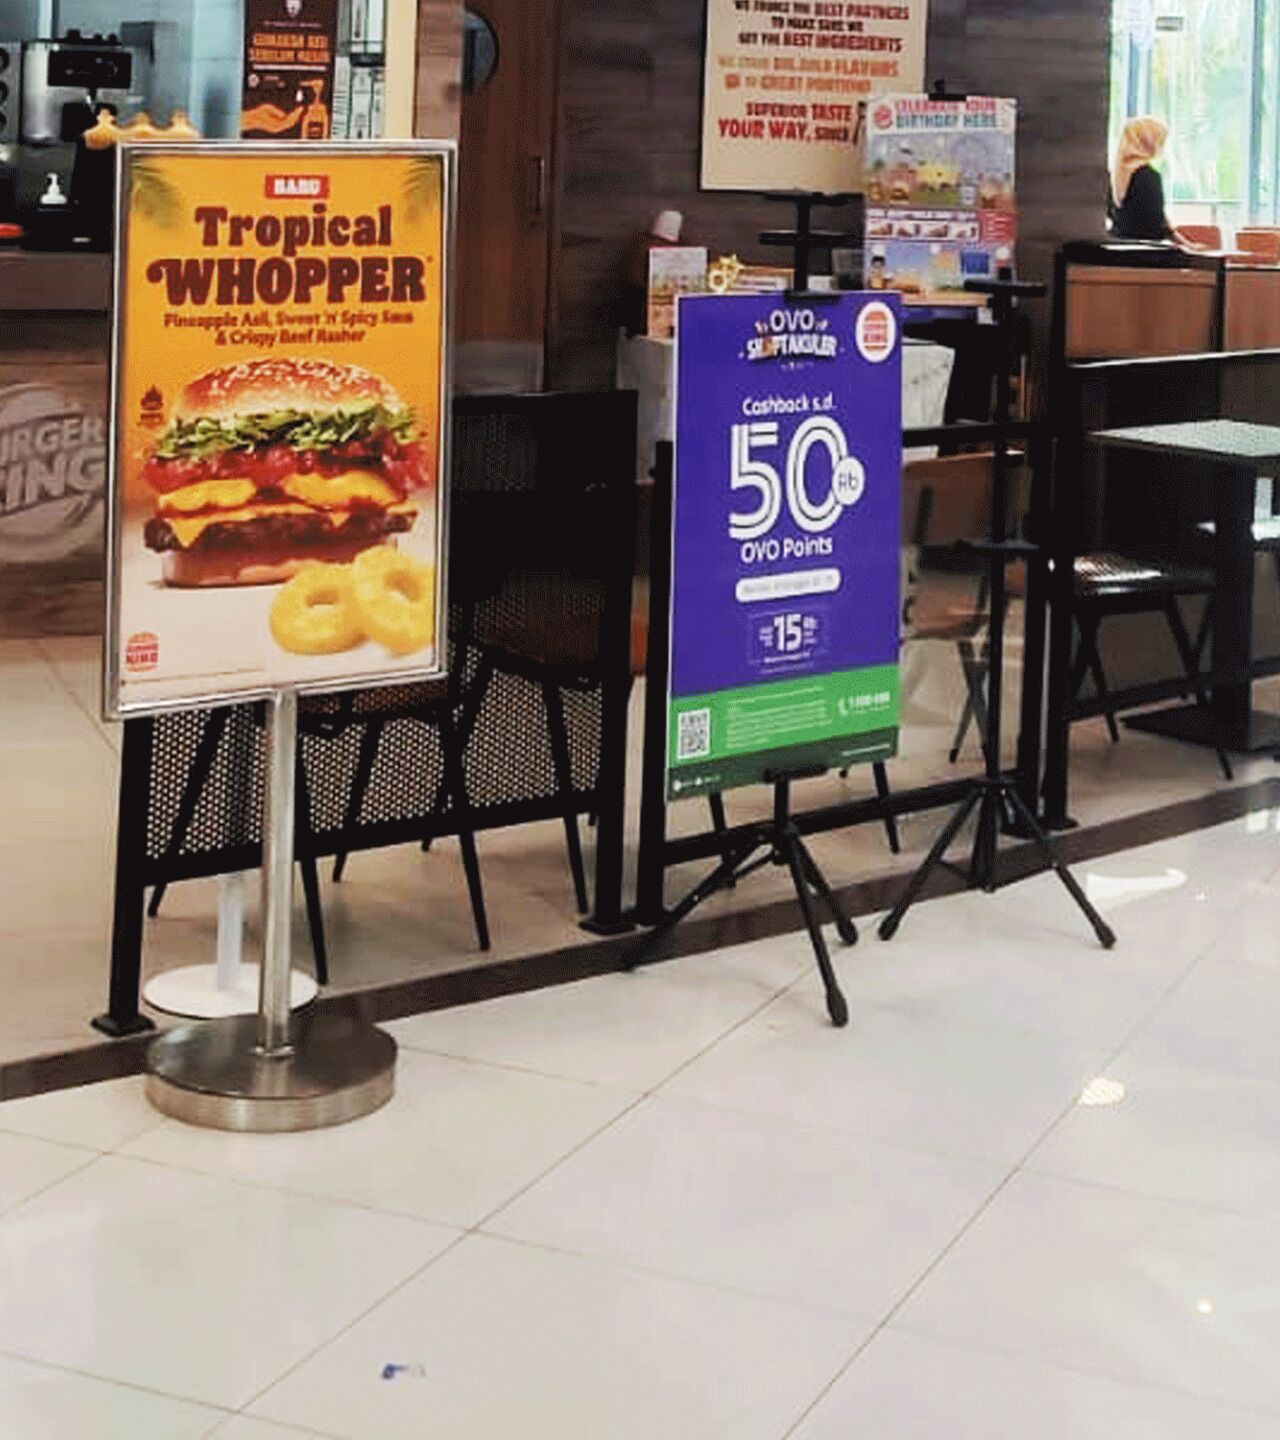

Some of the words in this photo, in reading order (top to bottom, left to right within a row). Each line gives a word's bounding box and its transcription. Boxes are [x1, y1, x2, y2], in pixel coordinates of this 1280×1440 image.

[783, 33, 813, 48] BEST
[816, 35, 902, 54] INGREDIENTS
[746, 102, 806, 116] SUPERIOR
[811, 104, 852, 121] TASTE
[718, 120, 765, 140] YOUR
[770, 122, 811, 143] WAY,
[194, 204, 392, 256] Tropical
[146, 256, 427, 306] WHOPPER
[163, 312, 238, 328] Pineapple
[275, 311, 321, 326] Sweet
[340, 310, 379, 326] Spicy
[770, 310, 815, 332] OVO
[214, 331, 227, 346] &
[229, 328, 278, 347] Crispy
[279, 328, 313, 343] Beef
[315, 328, 366, 342] Rasher
[742, 394, 809, 416] Cashback
[728, 415, 848, 540] 50
[741, 543, 778, 563] OVO
[783, 537, 833, 558] Points
[773, 613, 802, 651] 15
